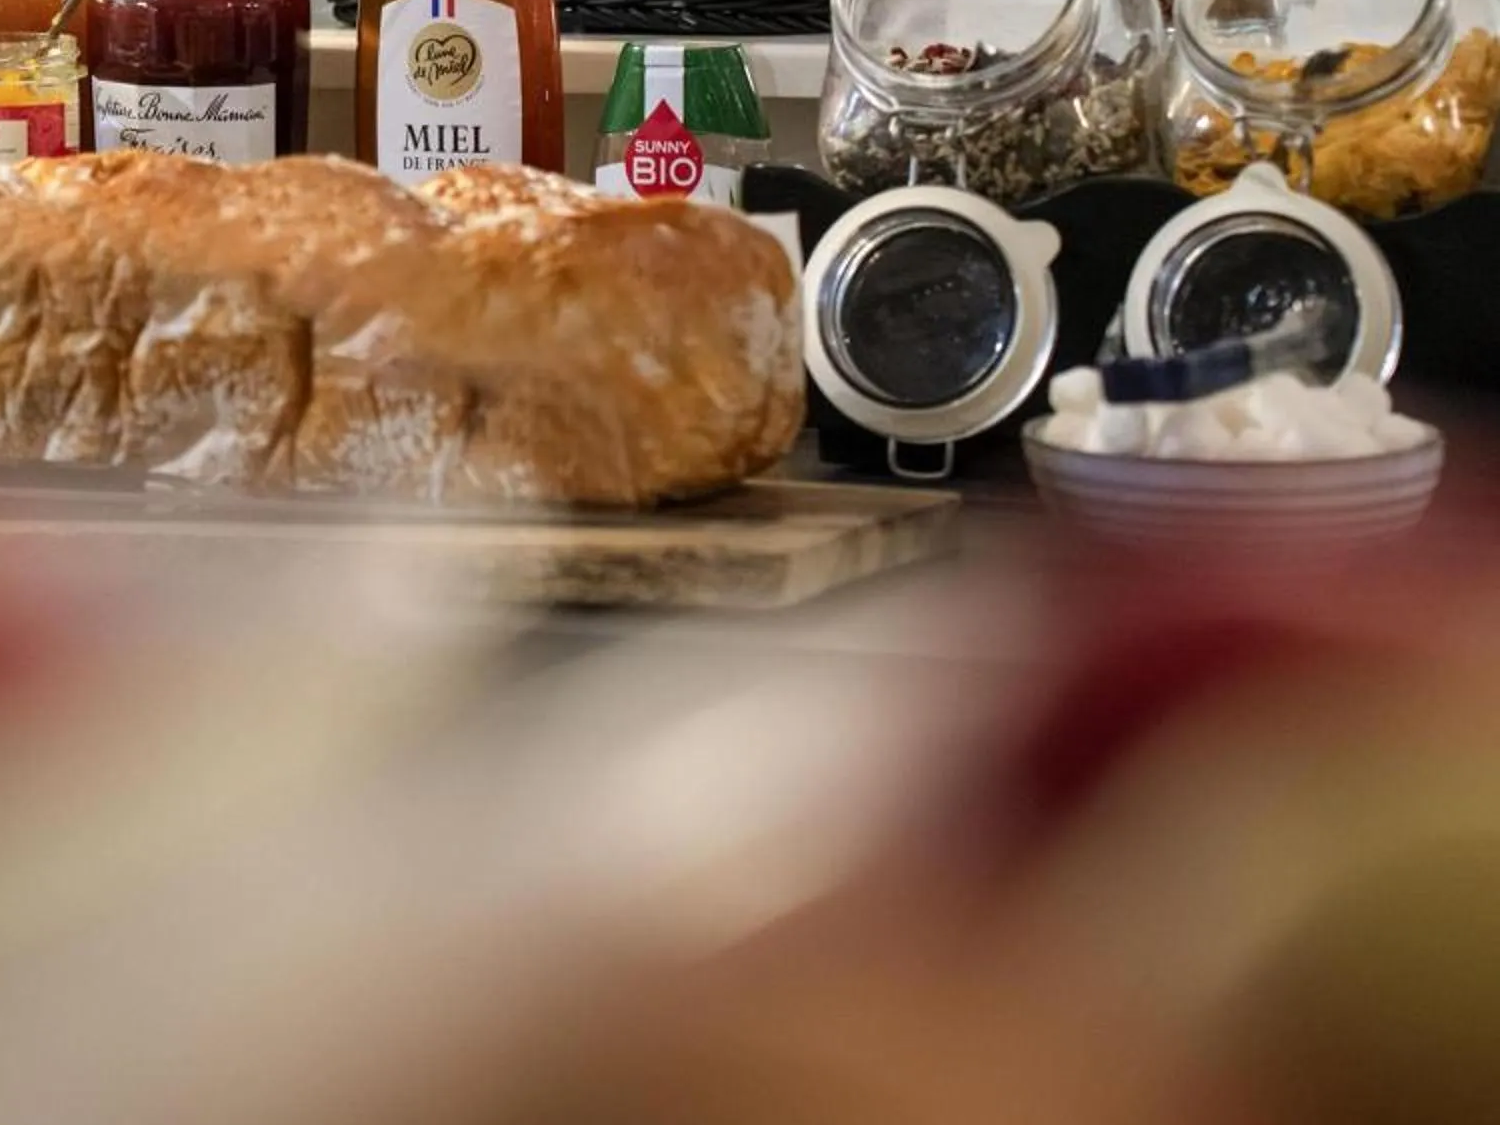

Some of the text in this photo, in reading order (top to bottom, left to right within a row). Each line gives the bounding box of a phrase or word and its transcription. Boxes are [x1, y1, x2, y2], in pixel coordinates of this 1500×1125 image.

[137, 92, 194, 121] Bonne
[403, 123, 491, 154] MIEL
[634, 139, 691, 154] SUNNY
[632, 156, 697, 187] BIO
